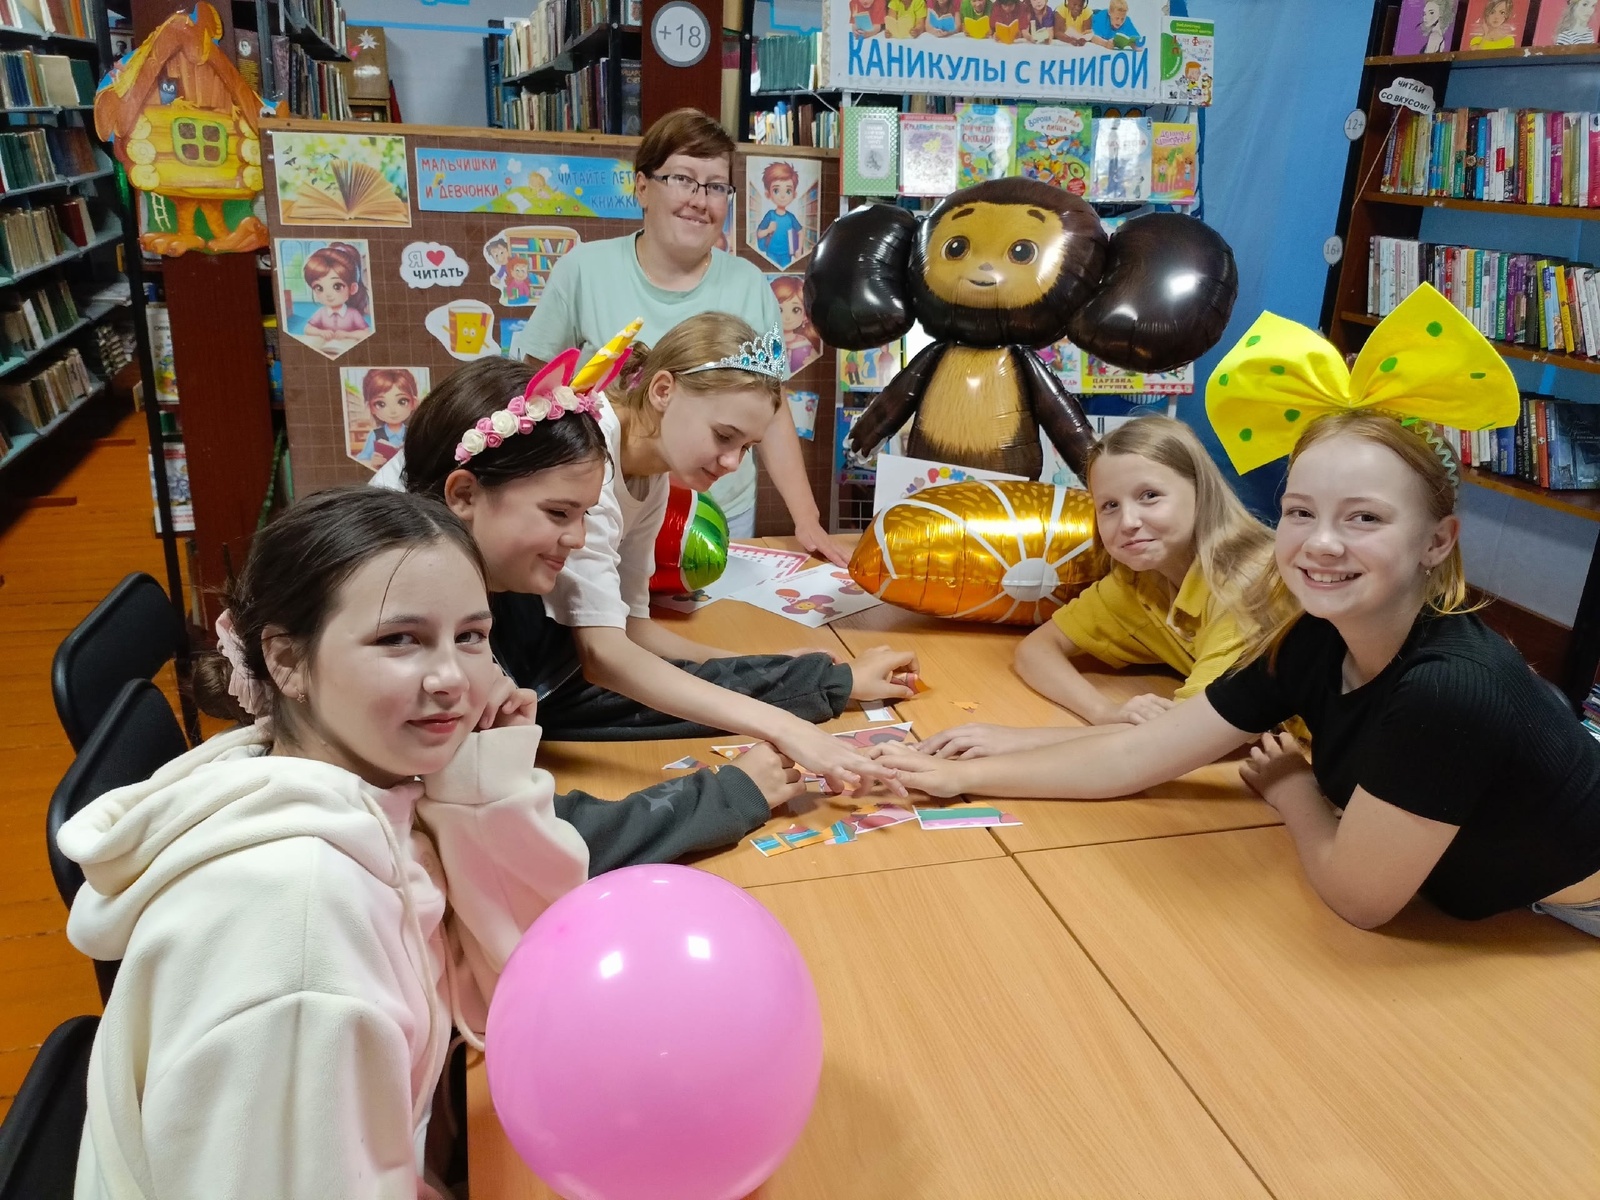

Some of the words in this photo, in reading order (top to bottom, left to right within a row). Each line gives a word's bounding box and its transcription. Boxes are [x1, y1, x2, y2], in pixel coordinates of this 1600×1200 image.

[658, 23, 702, 48] +18
[848, 31, 1006, 82] КАНИКУЛЫ
[1039, 36, 1148, 90] КНИГОЙ
[1380, 91, 1393, 100] СО
[1393, 94, 1431, 112] ВКУСОМ!
[1346, 118, 1364, 130] 12+
[421, 158, 497, 171] МАЛЬЧИШКИ
[558, 169, 606, 185] ЧИТАЙТЕ
[425, 186, 433, 198] И
[1325, 244, 1341, 255] 16+
[408, 250, 424, 268] Я
[413, 268, 464, 279] ЧИТАТЬ
